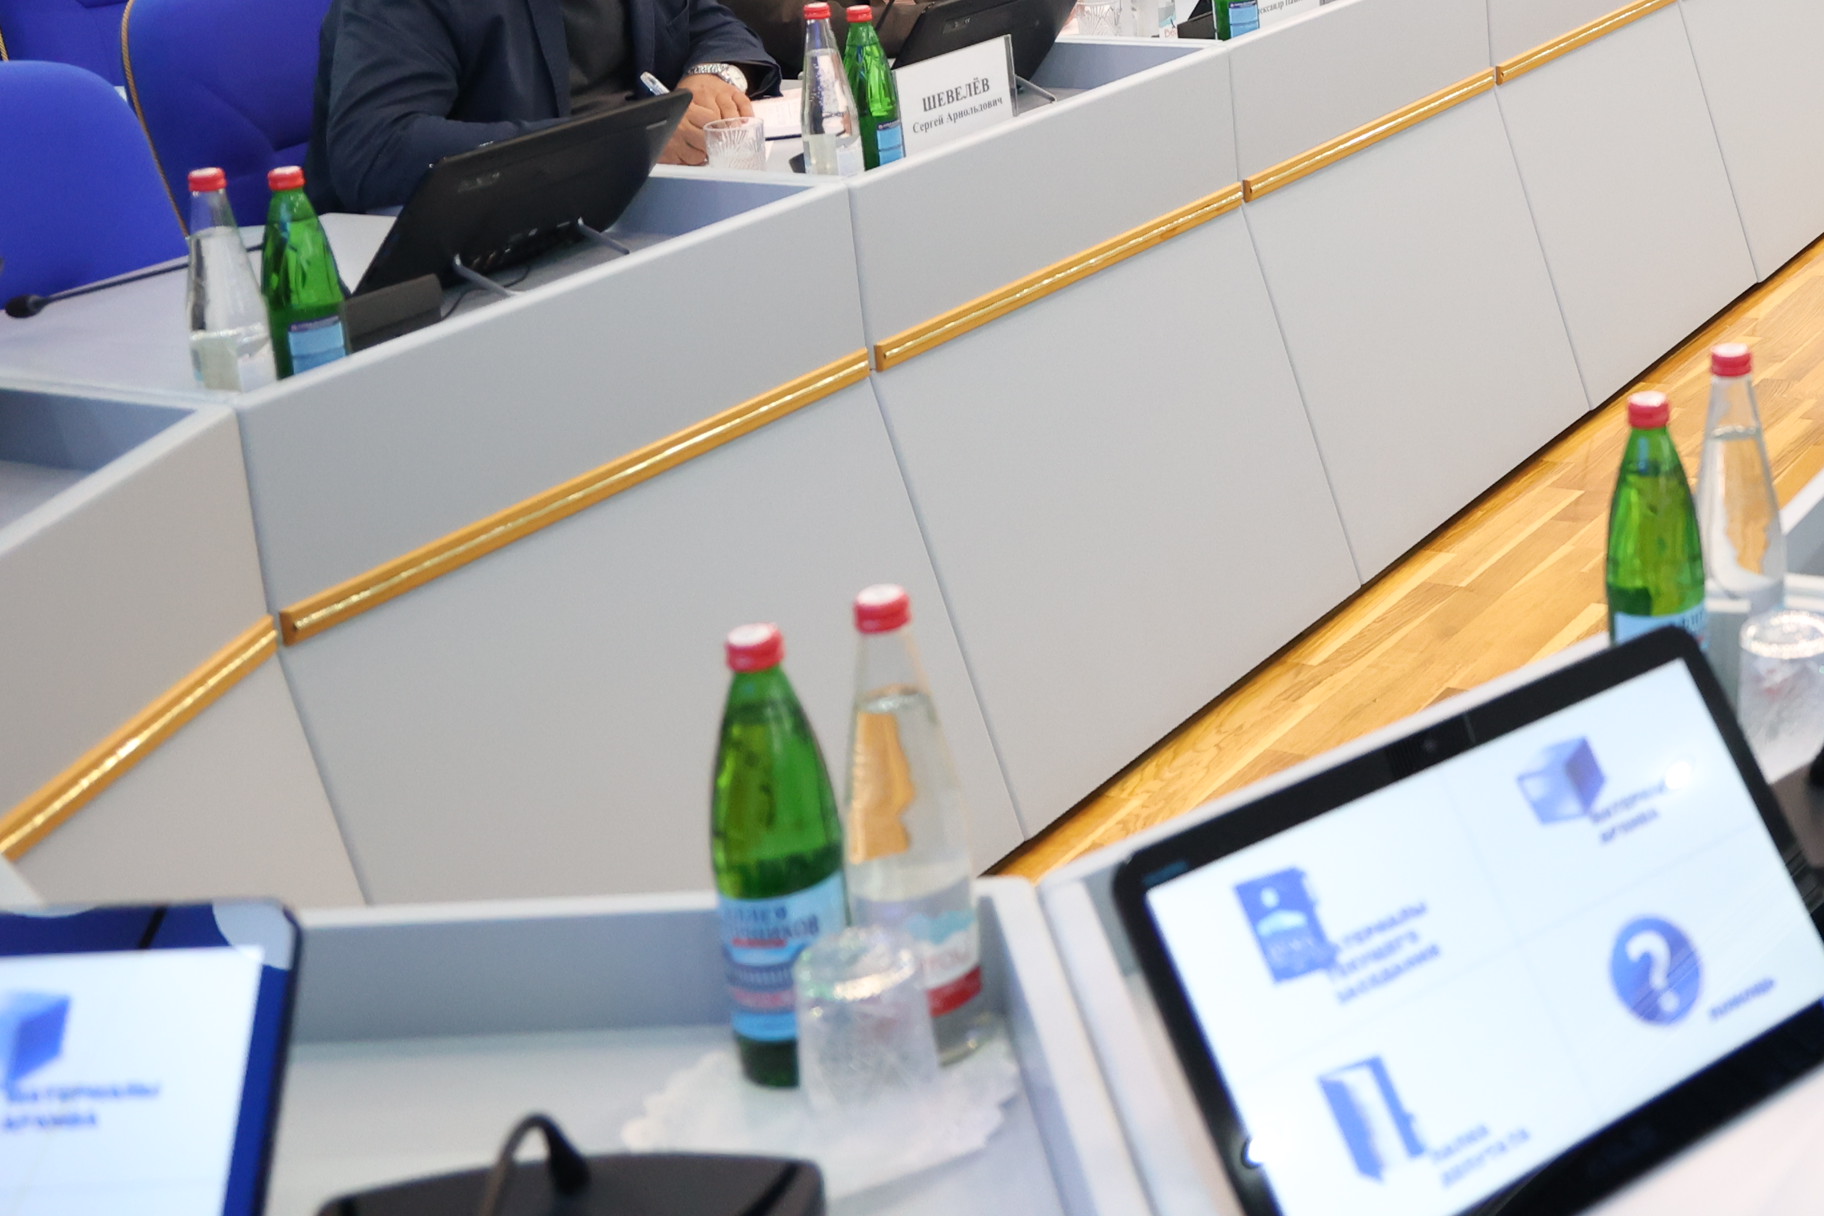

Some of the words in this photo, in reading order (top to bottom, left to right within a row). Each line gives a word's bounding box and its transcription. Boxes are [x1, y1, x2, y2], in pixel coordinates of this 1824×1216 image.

[1259, 0, 1284, 15] ександр
[922, 77, 990, 112] ШЕВЕЛЁВ
[912, 115, 944, 134] Сергей
[946, 96, 1003, 124] Арнольдович
